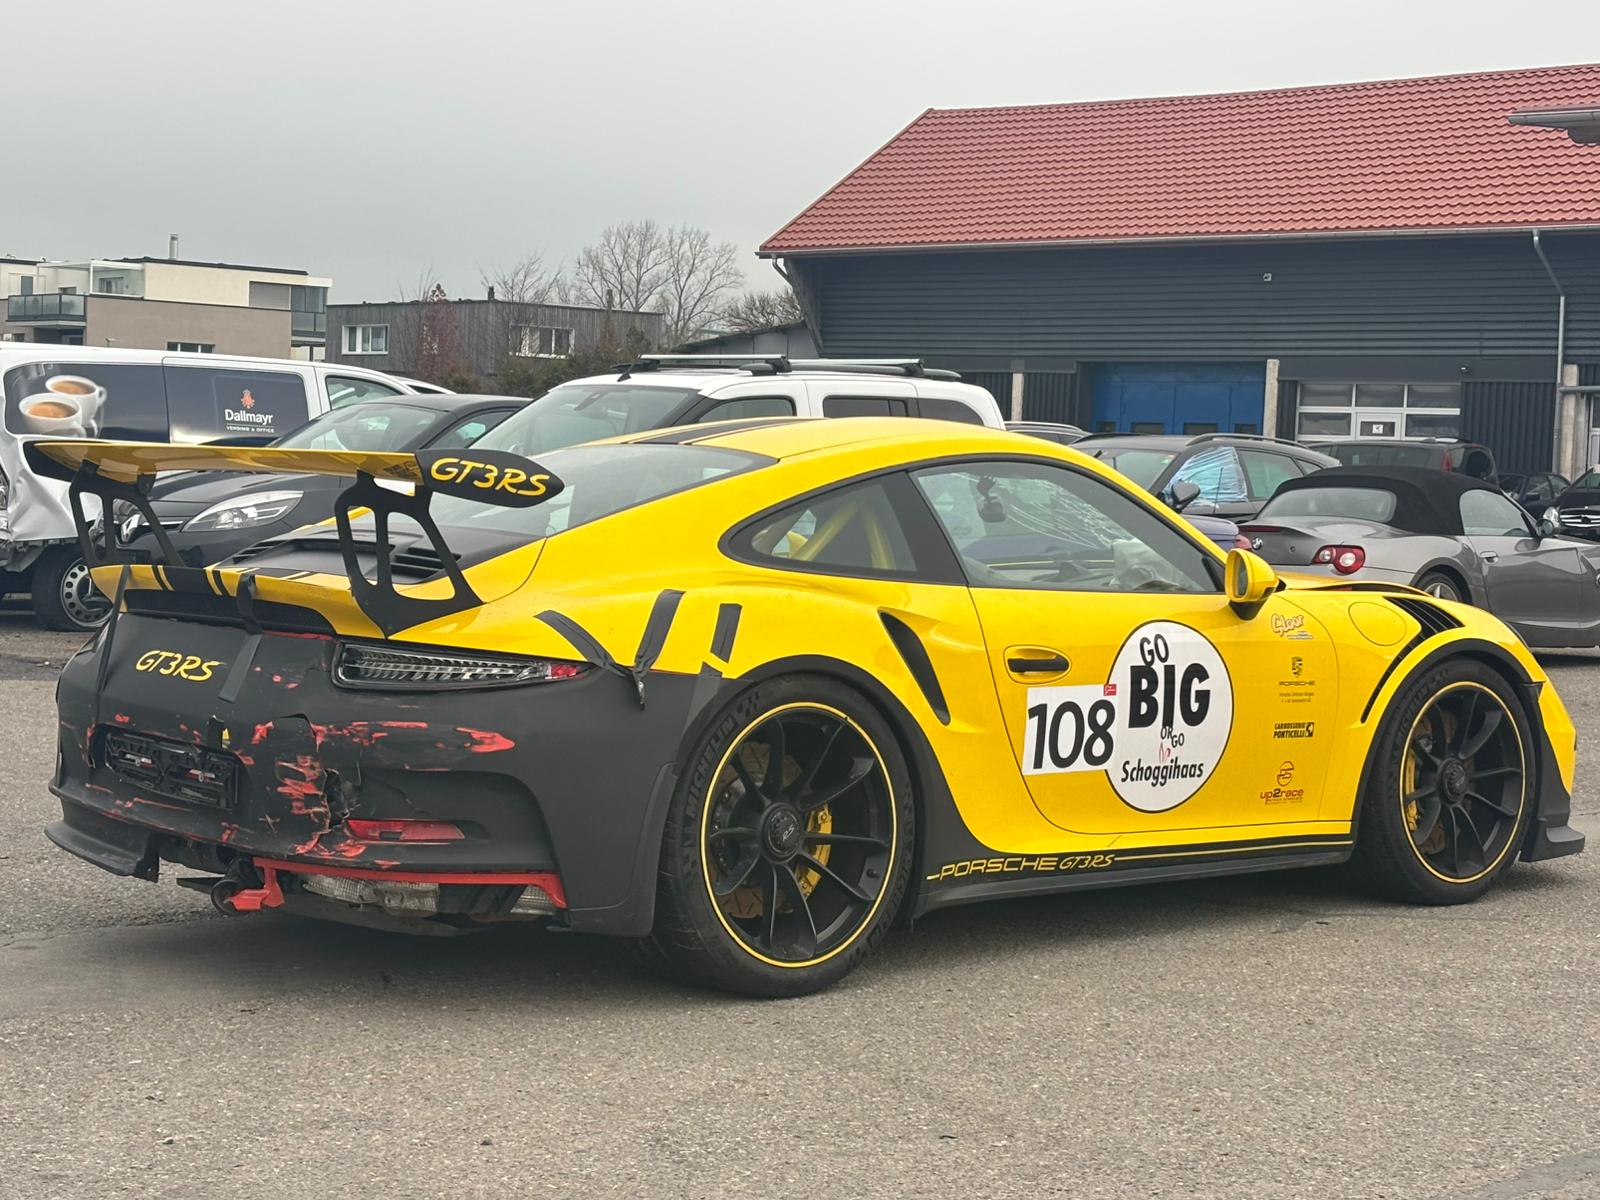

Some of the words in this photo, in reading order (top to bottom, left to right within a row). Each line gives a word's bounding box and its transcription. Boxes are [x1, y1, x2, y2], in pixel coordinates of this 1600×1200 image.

[224, 409, 273, 425] Dallmayr
[430, 457, 550, 496] GT3RS
[135, 650, 224, 681] GT3RS
[1139, 633, 1169, 667] GO
[1128, 663, 1211, 729] BIG
[1027, 699, 1116, 770] 108
[1160, 725, 1173, 740] OR
[1171, 732, 1185, 748] GO
[1120, 756, 1204, 788] Schoggihaas
[1260, 788, 1304, 805] up2race
[939, 857, 1059, 881] PORSCHE
[1058, 854, 1116, 870] GT3RS
